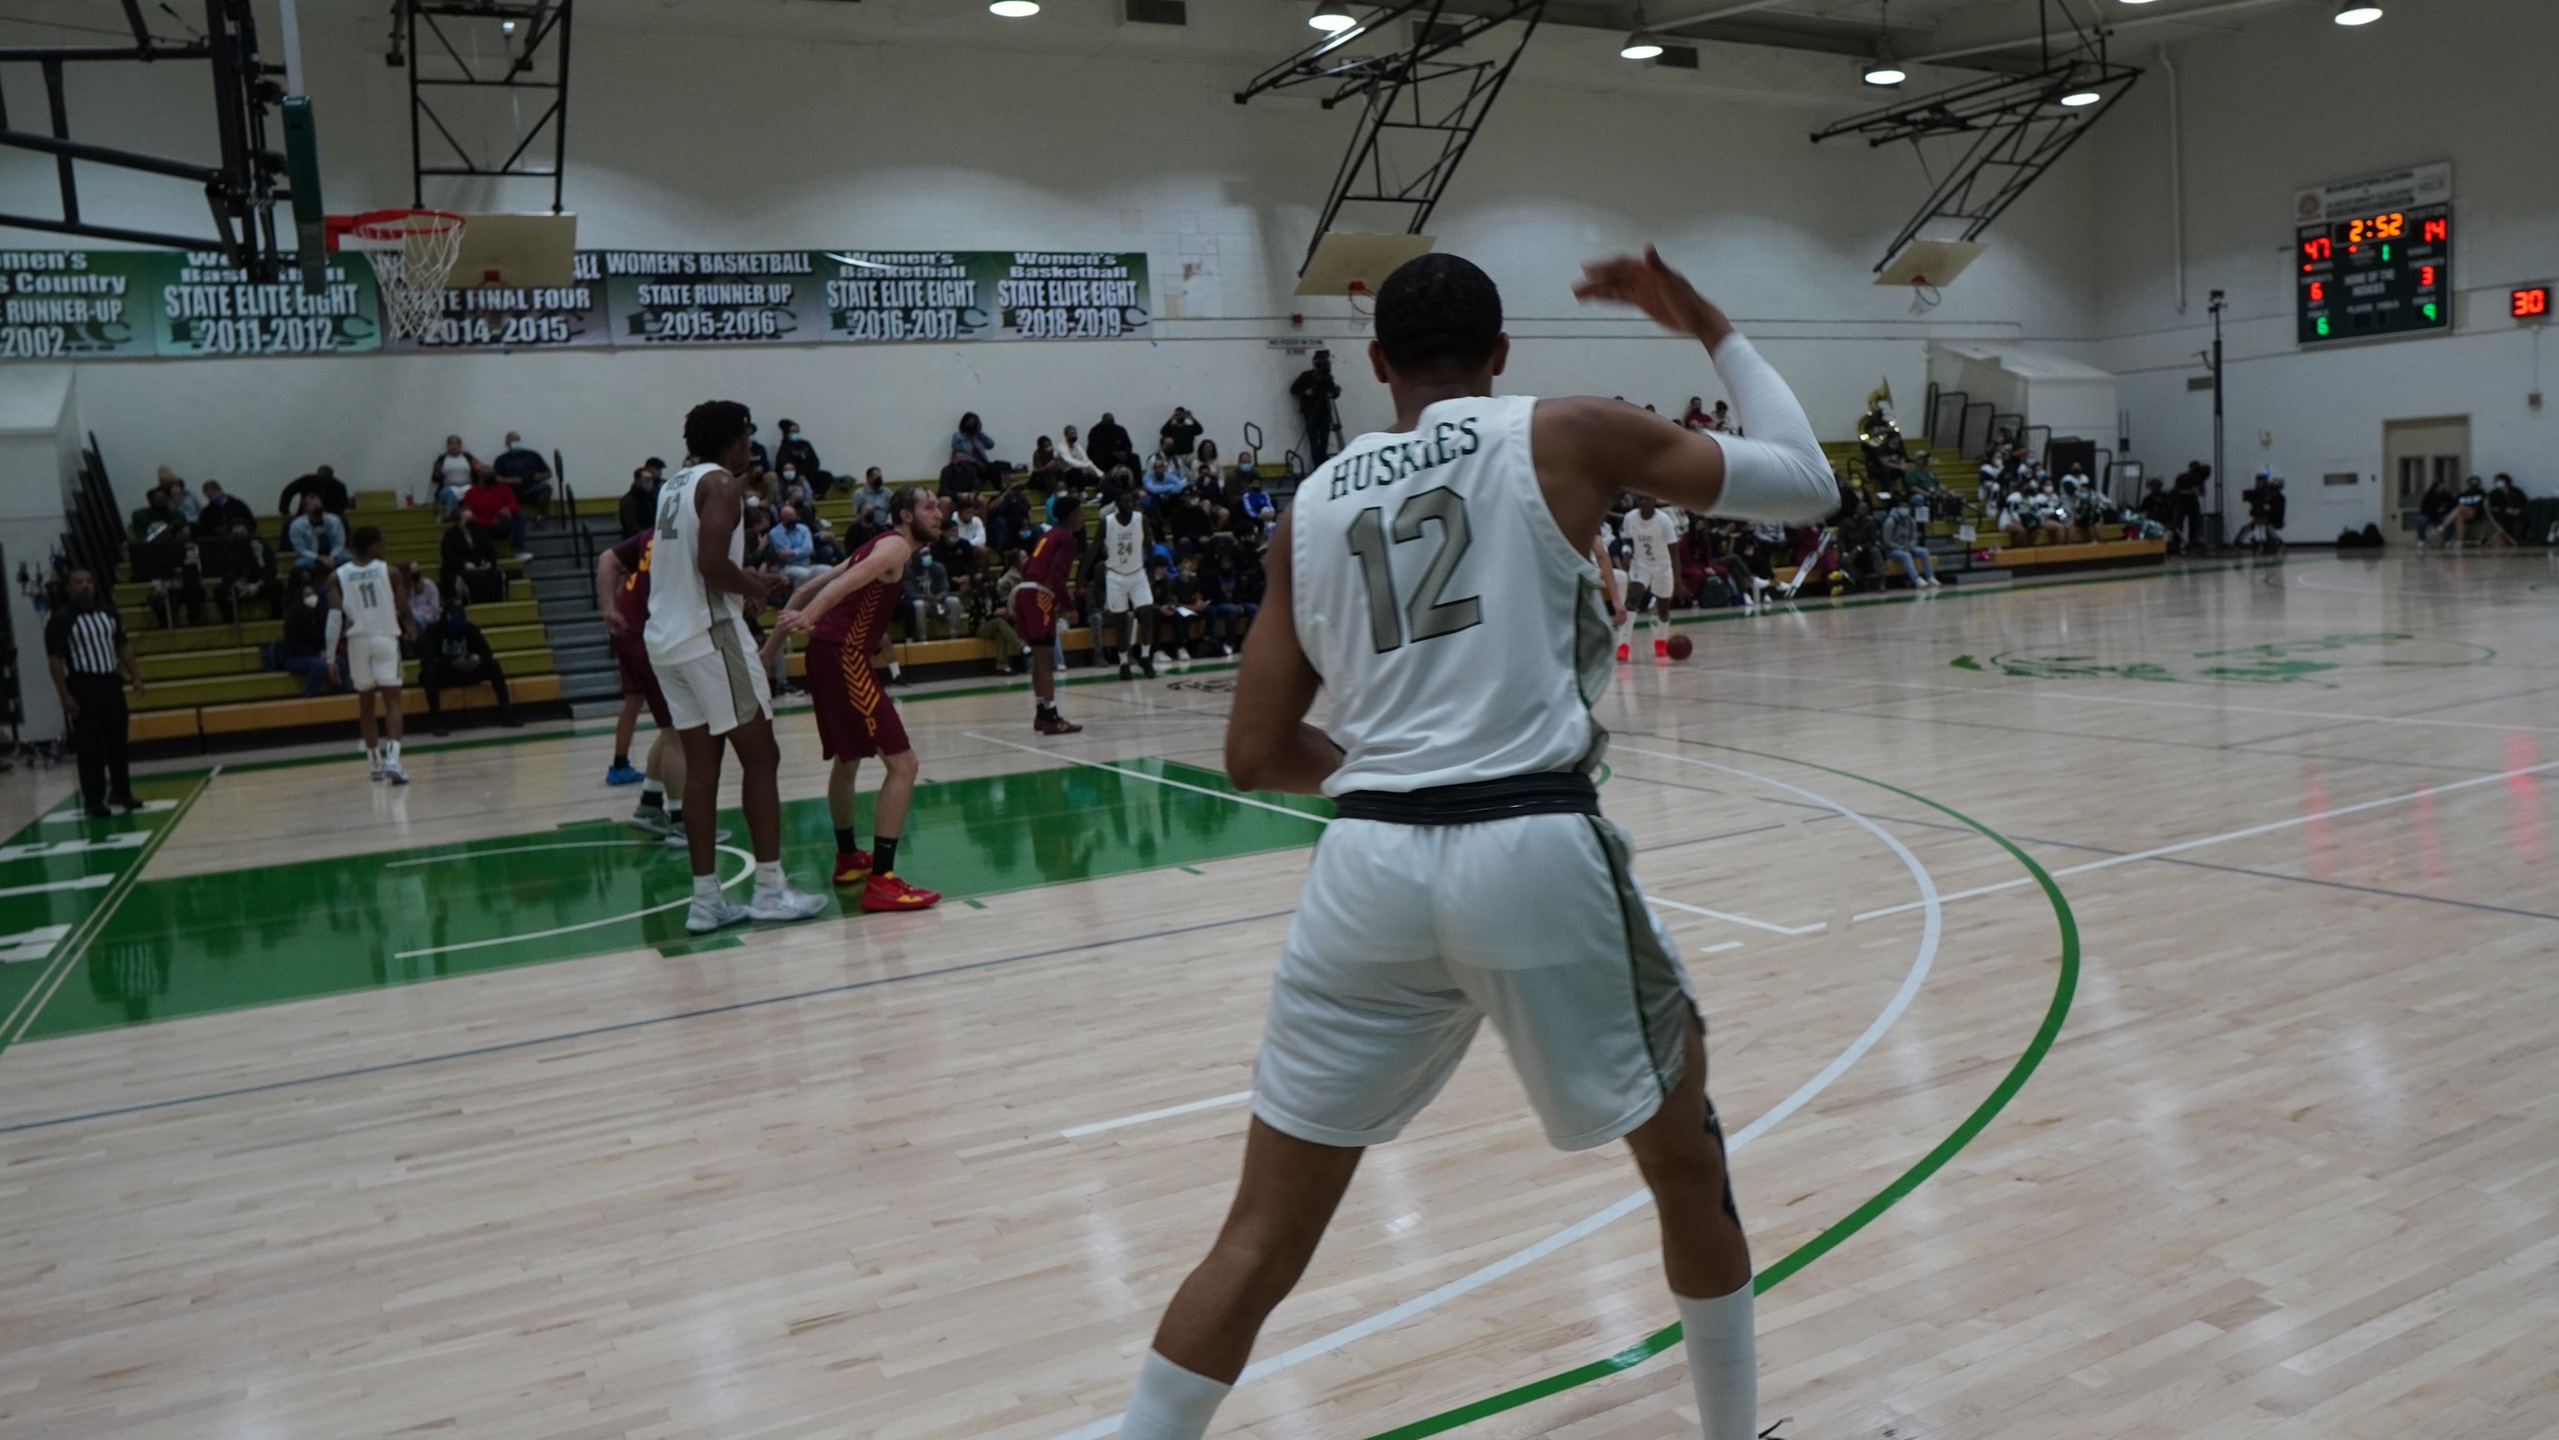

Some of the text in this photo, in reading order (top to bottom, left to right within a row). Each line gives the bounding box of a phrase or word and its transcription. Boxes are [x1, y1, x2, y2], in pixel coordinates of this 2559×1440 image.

[2349, 212, 2403, 242] 2:52
[2424, 218, 2447, 243] 14
[845, 251, 955, 266] Women's
[1014, 252, 1118, 266] Women's
[2304, 237, 2330, 260] 47
[2382, 244, 2390, 261] 1
[606, 252, 696, 275] WOMEN'S
[699, 252, 813, 274] BASKETBALL
[839, 265, 967, 279] Basketball
[1009, 265, 1129, 279] Basketball
[2421, 265, 2435, 286] 3
[15, 272, 127, 296] Country
[638, 283, 793, 306] STATE RUNNER UP
[826, 280, 977, 308] STATE ELITE EIGHT
[997, 280, 1138, 308] STATE ELITE EIGHT
[2310, 281, 2323, 301] 6
[164, 284, 232, 319] STATE
[235, 284, 292, 318] ELITE
[296, 283, 359, 316] EIGHT
[466, 288, 530, 311] FINAL
[533, 287, 593, 310] FOUR
[2513, 288, 2545, 316] 30
[6, 299, 123, 324] RUNNER-UP
[661, 311, 776, 336] 2015-2016
[1021, 308, 1122, 339] 2018-2019
[2422, 303, 2436, 321] 9
[200, 318, 334, 353] 2011-2012
[853, 308, 958, 340] 2016-2017
[2316, 316, 2329, 335] 6
[1328, 417, 1479, 501] HUSKIES
[1117, 542, 1133, 556] 24
[1643, 543, 1653, 556] 2
[1345, 485, 1483, 655] 12
[358, 582, 377, 608] 11
